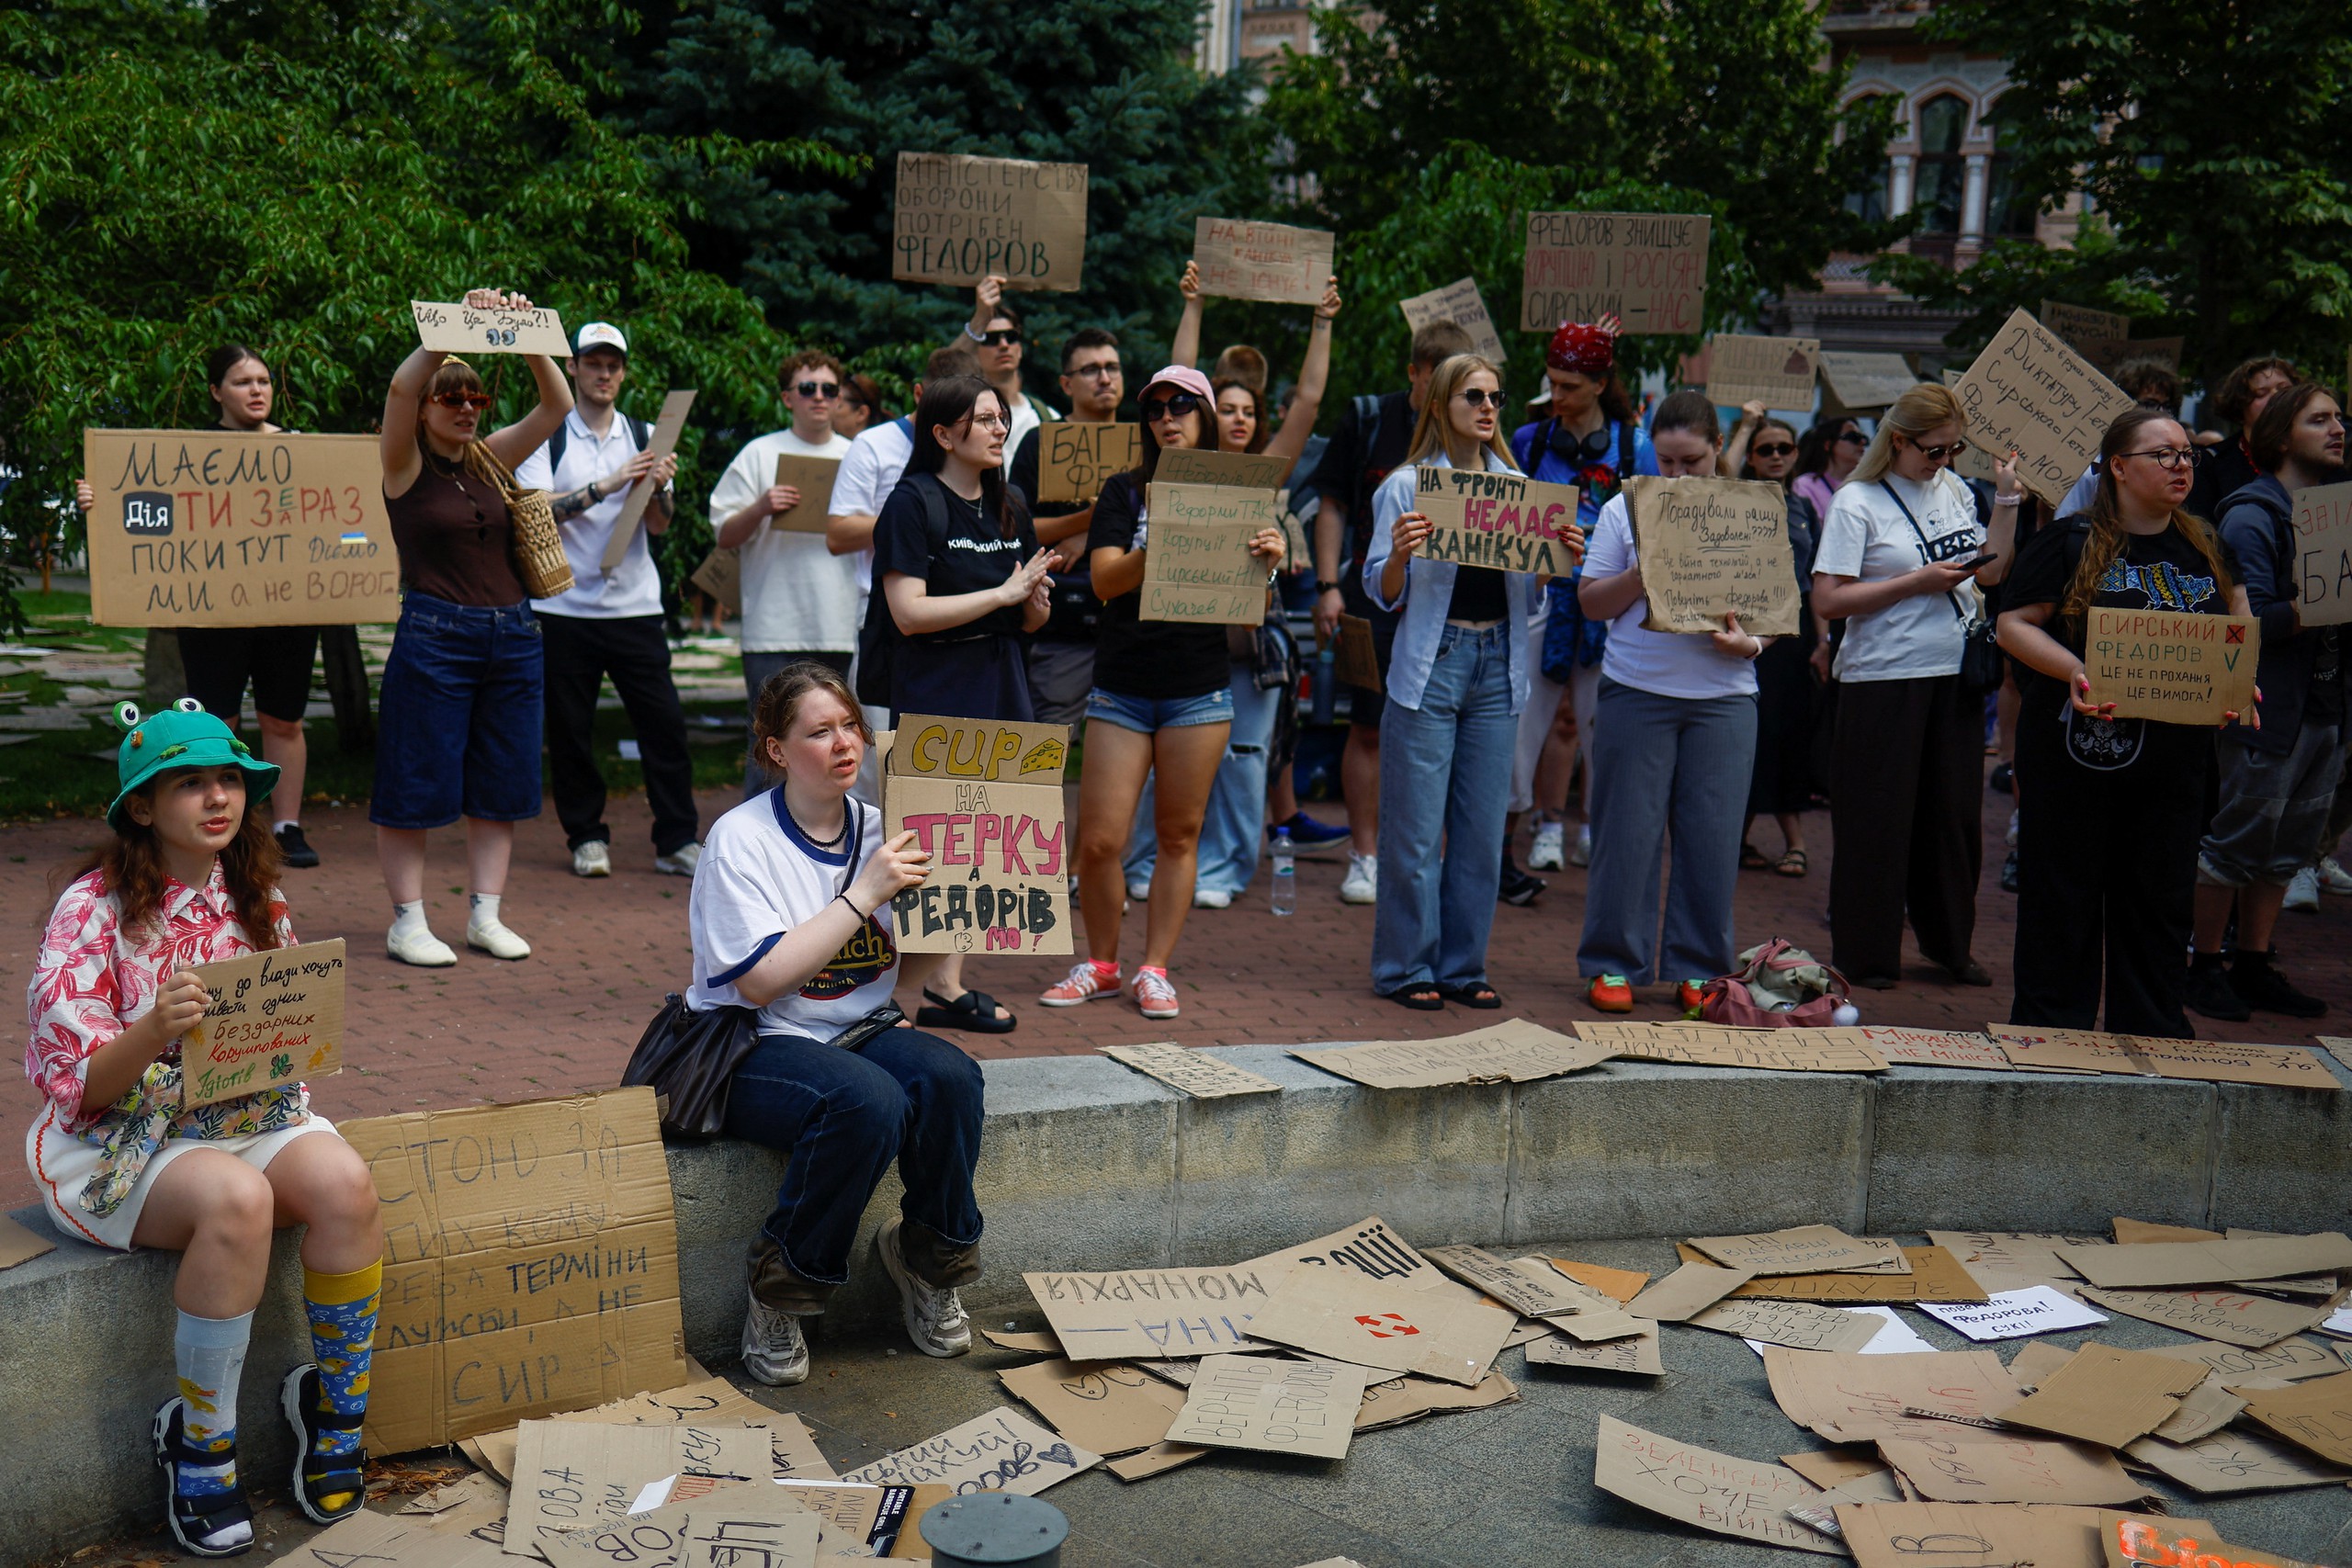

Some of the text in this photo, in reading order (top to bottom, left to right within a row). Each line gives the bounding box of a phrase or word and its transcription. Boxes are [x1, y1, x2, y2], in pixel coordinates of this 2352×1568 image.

[899, 186, 1012, 216] ОБОРОНИ
[898, 212, 1023, 241] ПОТРІБЕН
[1207, 224, 1237, 243] НА
[1528, 215, 1693, 249] ФЕДОРОВ ЗНИЩУЄ
[897, 234, 1050, 277] ФЕДОРОВ
[1209, 265, 1238, 289] НЕ
[1646, 293, 1691, 331] НАС
[1050, 424, 1116, 466] БАГ
[110, 442, 292, 491] МАЄМО
[1244, 462, 1283, 490] ТАК
[1419, 467, 1442, 492] НА
[1238, 499, 1273, 522] ТАК
[1463, 497, 1567, 540] НЕМАЄ
[131, 538, 225, 575] ПОКИ
[237, 534, 291, 566] ТУТ
[146, 581, 214, 613] МИ
[2098, 612, 2216, 643] СИРСЬКИЙ
[2095, 639, 2203, 663] ФЕДОРОВ
[2100, 664, 2123, 681] ЦЕ
[2126, 667, 2144, 680] НЕ
[2126, 685, 2147, 701] ЦЕ
[956, 784, 991, 813] НА
[968, 866, 981, 882] А
[986, 925, 1023, 952] МО
[234, 977, 252, 998] до
[259, 955, 299, 987] влади
[301, 957, 344, 978] хочуть
[261, 991, 307, 1016] одних
[1931, 1049, 2007, 1063] МІНІСТР
[369, 1135, 539, 1203] СТОЮ
[1744, 1235, 1782, 1247] НІ
[1743, 1247, 1856, 1266] ФЕДОРОВА
[379, 1244, 648, 1312] РЕБА ТЕРМІНИ
[1047, 1269, 1271, 1303] МОНАРХІЯ
[598, 1284, 643, 1316] НЕ
[1624, 1433, 1817, 1497] ЗЕЛЕНСЬКИ
[1635, 1456, 1777, 1512] ХОЧЕ
[874, 1487, 899, 1532] BARBECUE GRILL
[891, 1487, 909, 1516] PORTABLE
